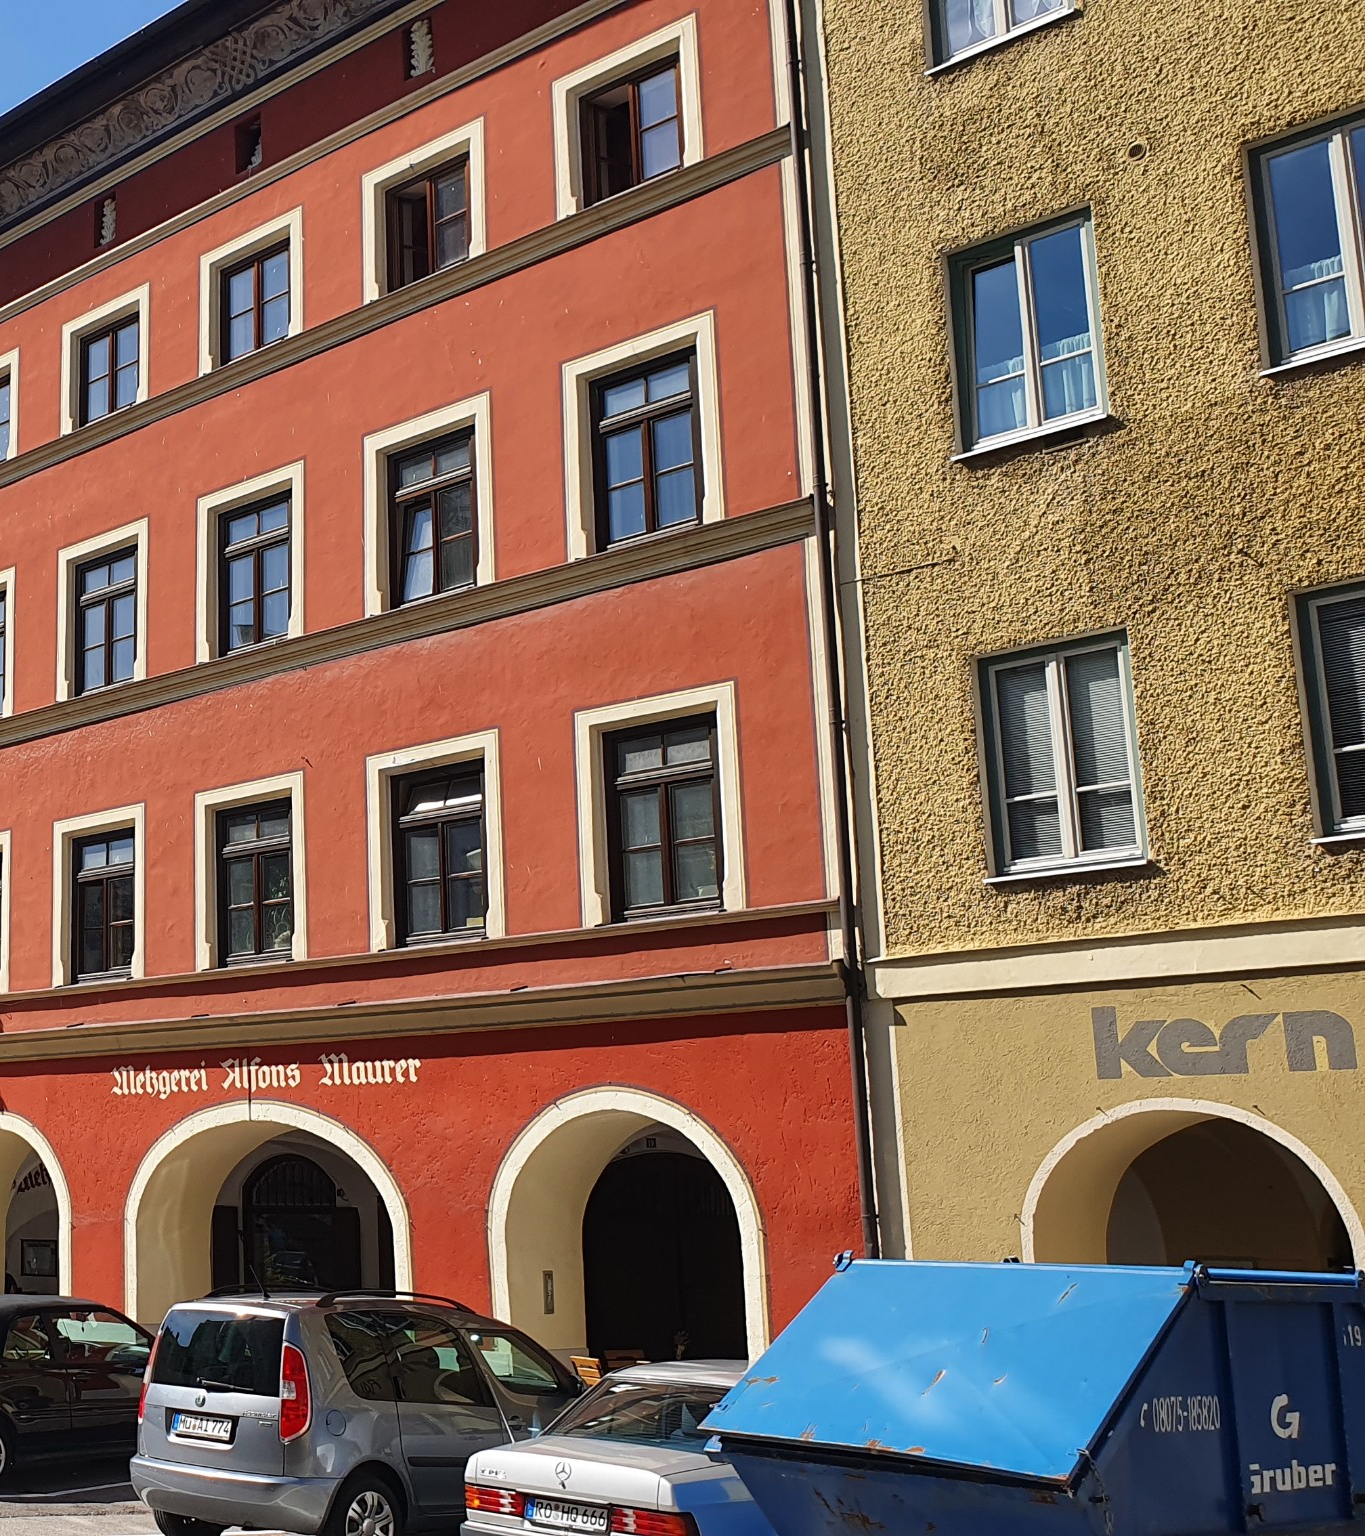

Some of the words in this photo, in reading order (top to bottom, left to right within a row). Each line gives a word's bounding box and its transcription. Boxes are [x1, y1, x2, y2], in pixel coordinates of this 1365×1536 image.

[1091, 1006, 1358, 1080] kern
[110, 1060, 208, 1100] Metzgerei
[219, 1056, 301, 1093] Alfons
[318, 1052, 423, 1087] Maurer
[1152, 1395, 1221, 1433] 08075-185820
